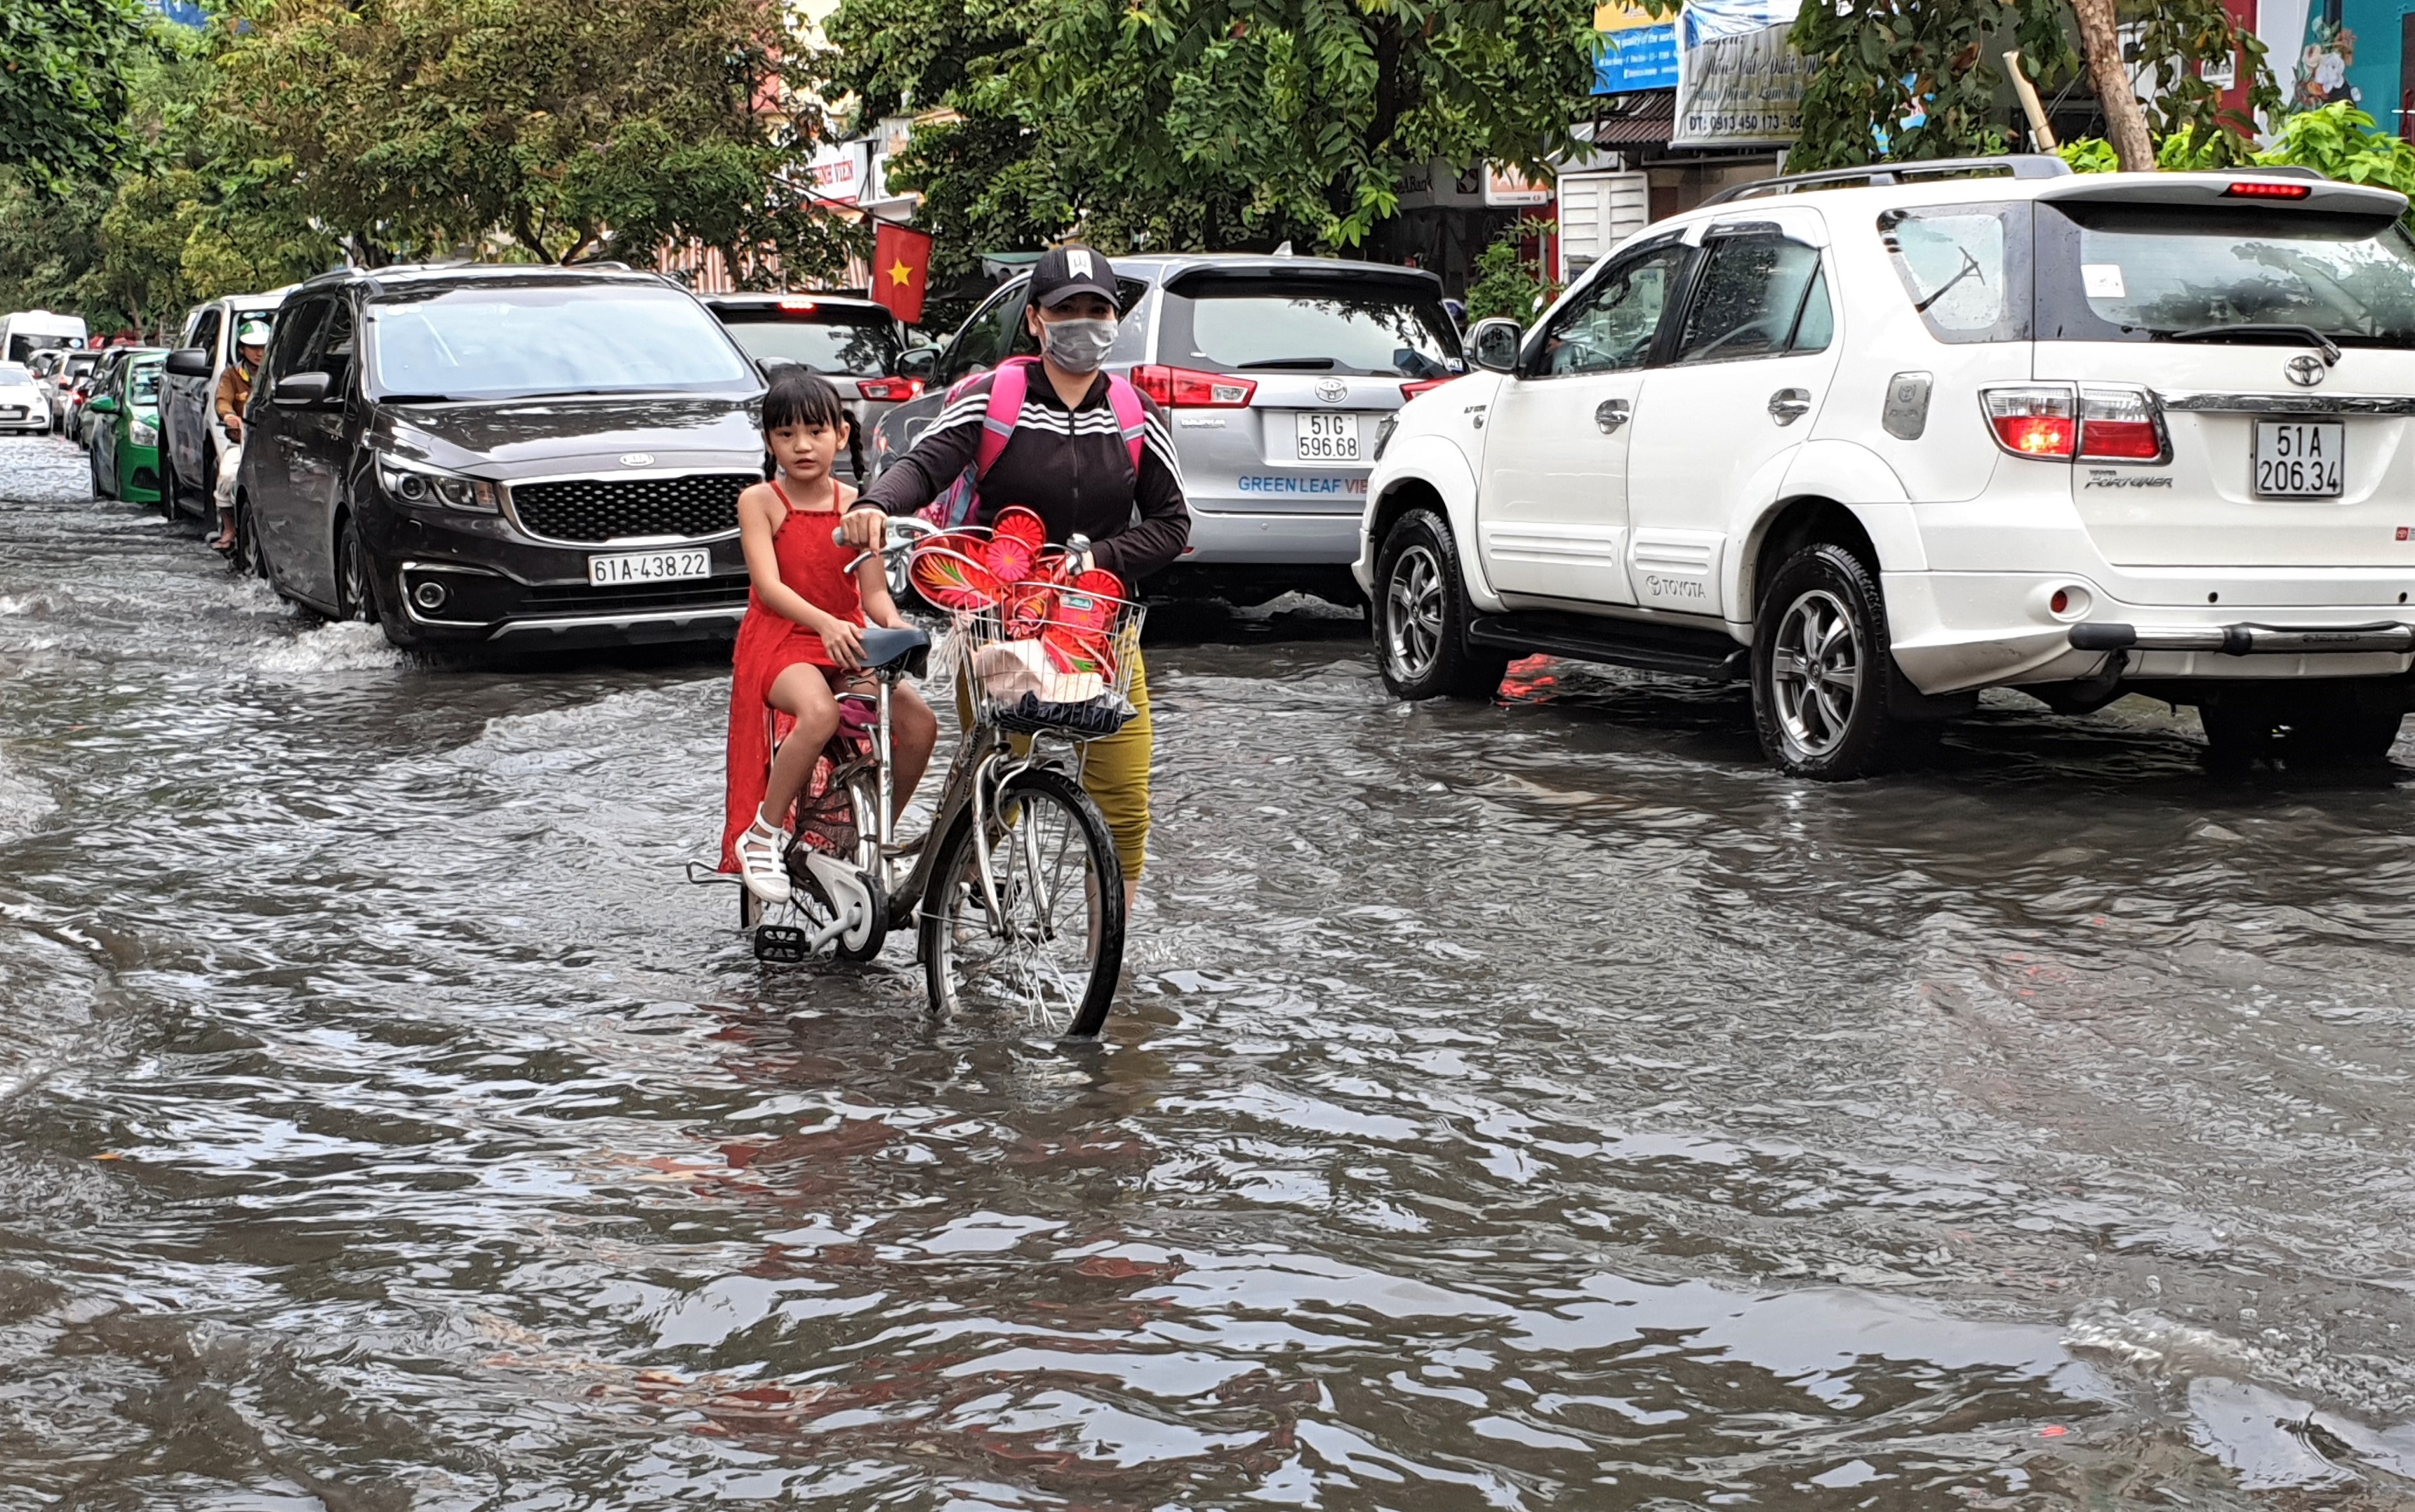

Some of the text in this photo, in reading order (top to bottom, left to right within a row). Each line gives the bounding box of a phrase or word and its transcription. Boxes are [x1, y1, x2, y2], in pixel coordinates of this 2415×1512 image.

[1710, 115, 1735, 131] 0913
[1739, 115, 1757, 131] 450
[1762, 115, 1780, 130] 173
[1311, 415, 1343, 436] 51G
[1300, 436, 1357, 457] 596.68
[2277, 426, 2322, 457] 51A
[1238, 476, 1296, 493] GREEN
[1300, 478, 1341, 494] LEAF
[2259, 460, 2339, 492] 206.34
[594, 554, 706, 582] 61A-438.22
[1662, 578, 1706, 599] TOYOTA
